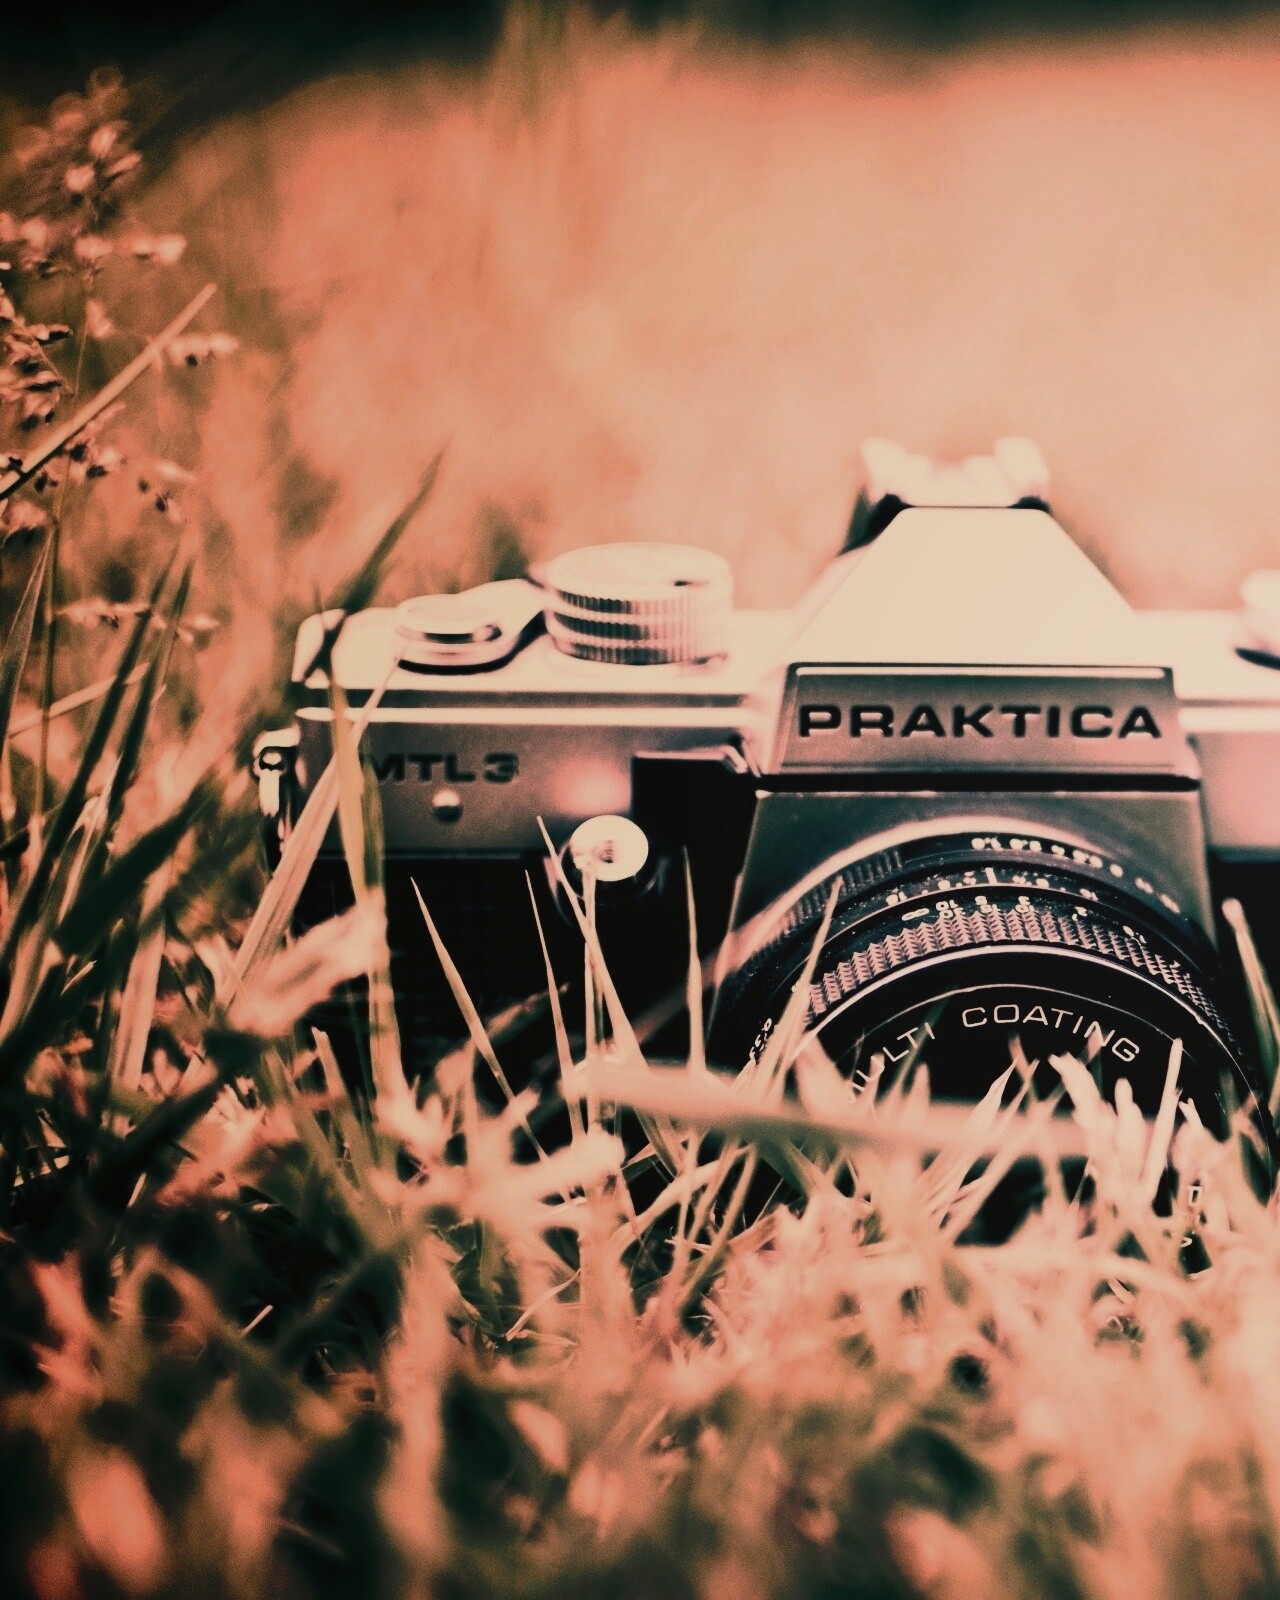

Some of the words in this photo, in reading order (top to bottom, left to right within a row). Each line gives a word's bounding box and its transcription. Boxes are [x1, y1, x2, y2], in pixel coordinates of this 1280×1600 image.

[799, 704, 1161, 739] PRAKTICA
[851, 1022, 936, 1092] ULTI
[962, 1004, 1140, 1062] COATING
